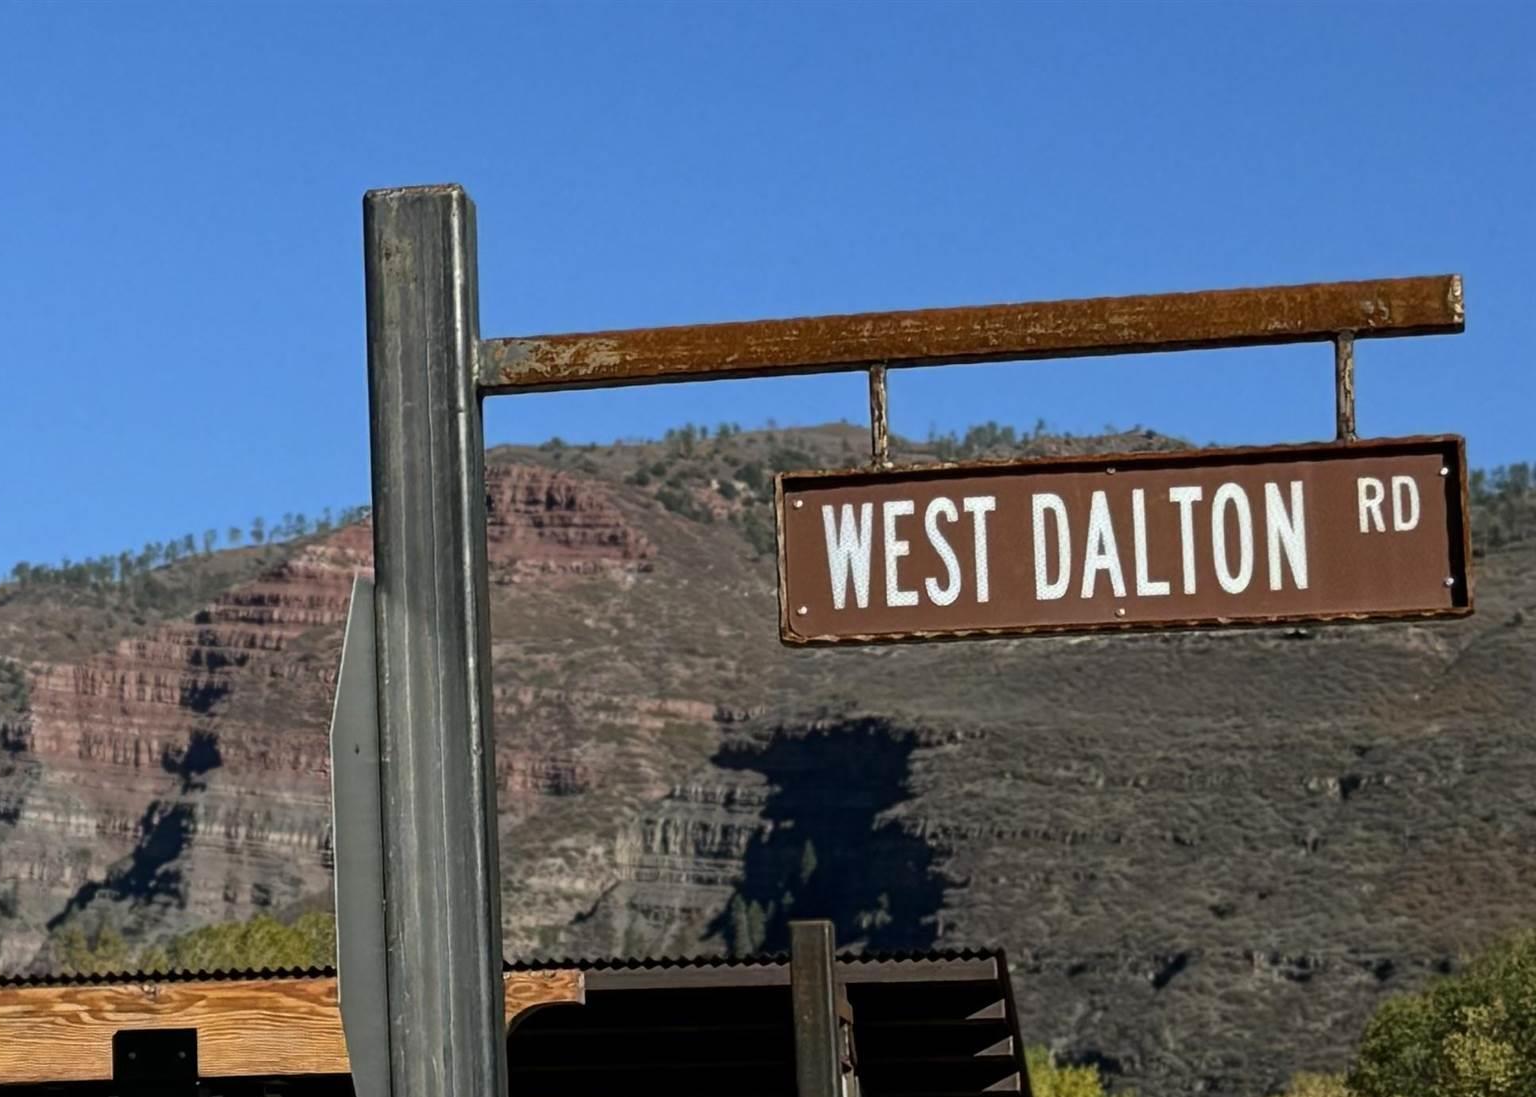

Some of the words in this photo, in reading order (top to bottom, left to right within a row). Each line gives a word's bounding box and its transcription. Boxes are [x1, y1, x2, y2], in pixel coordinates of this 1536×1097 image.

[822, 495, 996, 610] WEST
[1032, 480, 1308, 601] DALTON
[1357, 475, 1421, 533] RD
